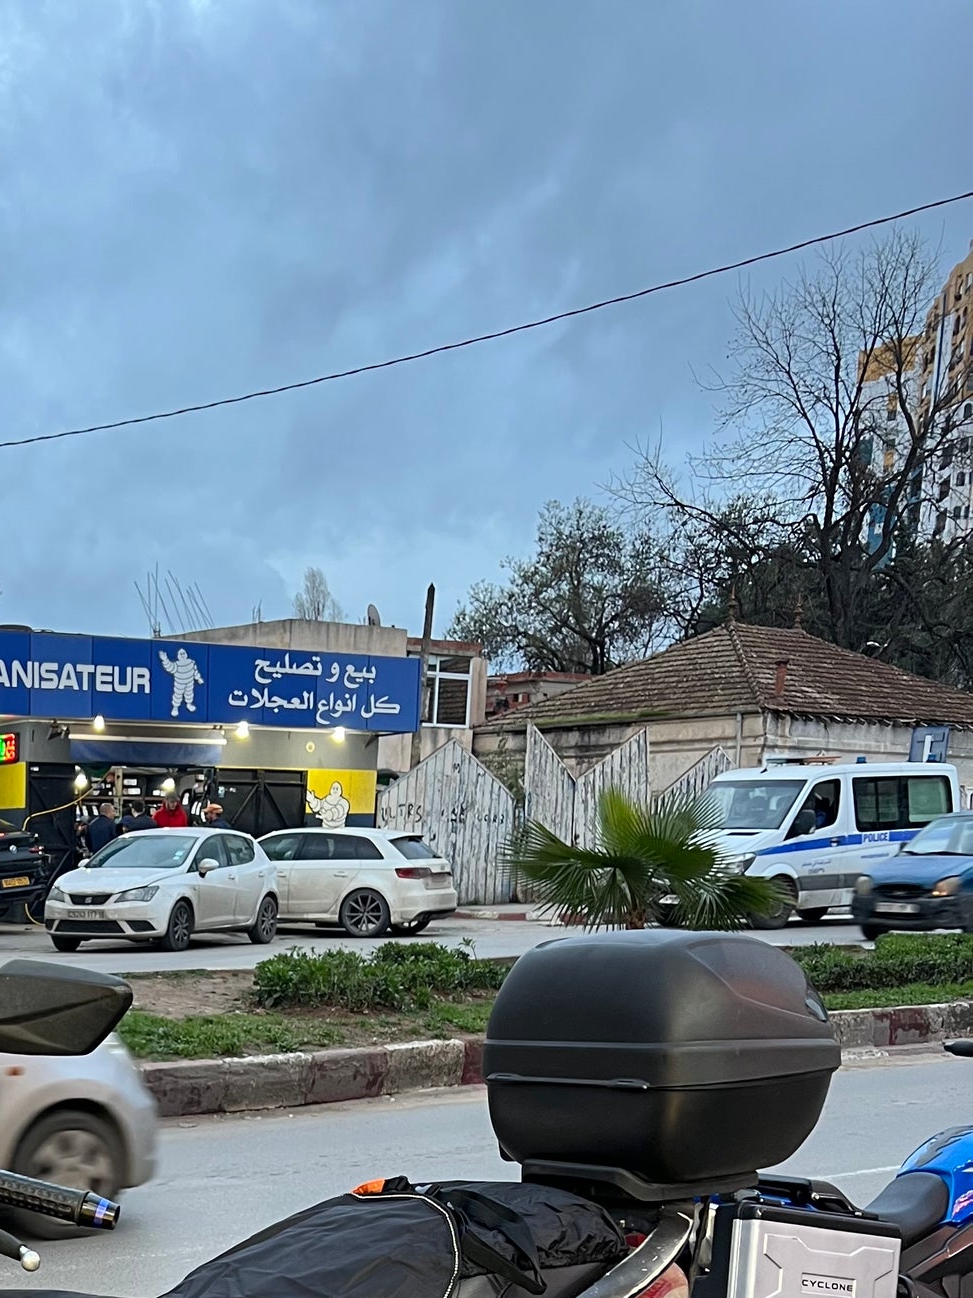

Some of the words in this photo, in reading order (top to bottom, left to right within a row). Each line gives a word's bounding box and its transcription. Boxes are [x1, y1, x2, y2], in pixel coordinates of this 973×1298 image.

[254, 652, 323, 684] تصليح
[343, 663, 377, 689] بيع
[228, 687, 314, 713] العجلات
[316, 691, 357, 725] انواع
[360, 694, 401, 719] كل
[863, 831, 888, 843] POLICE
[801, 1279, 853, 1292] CYCLONE
